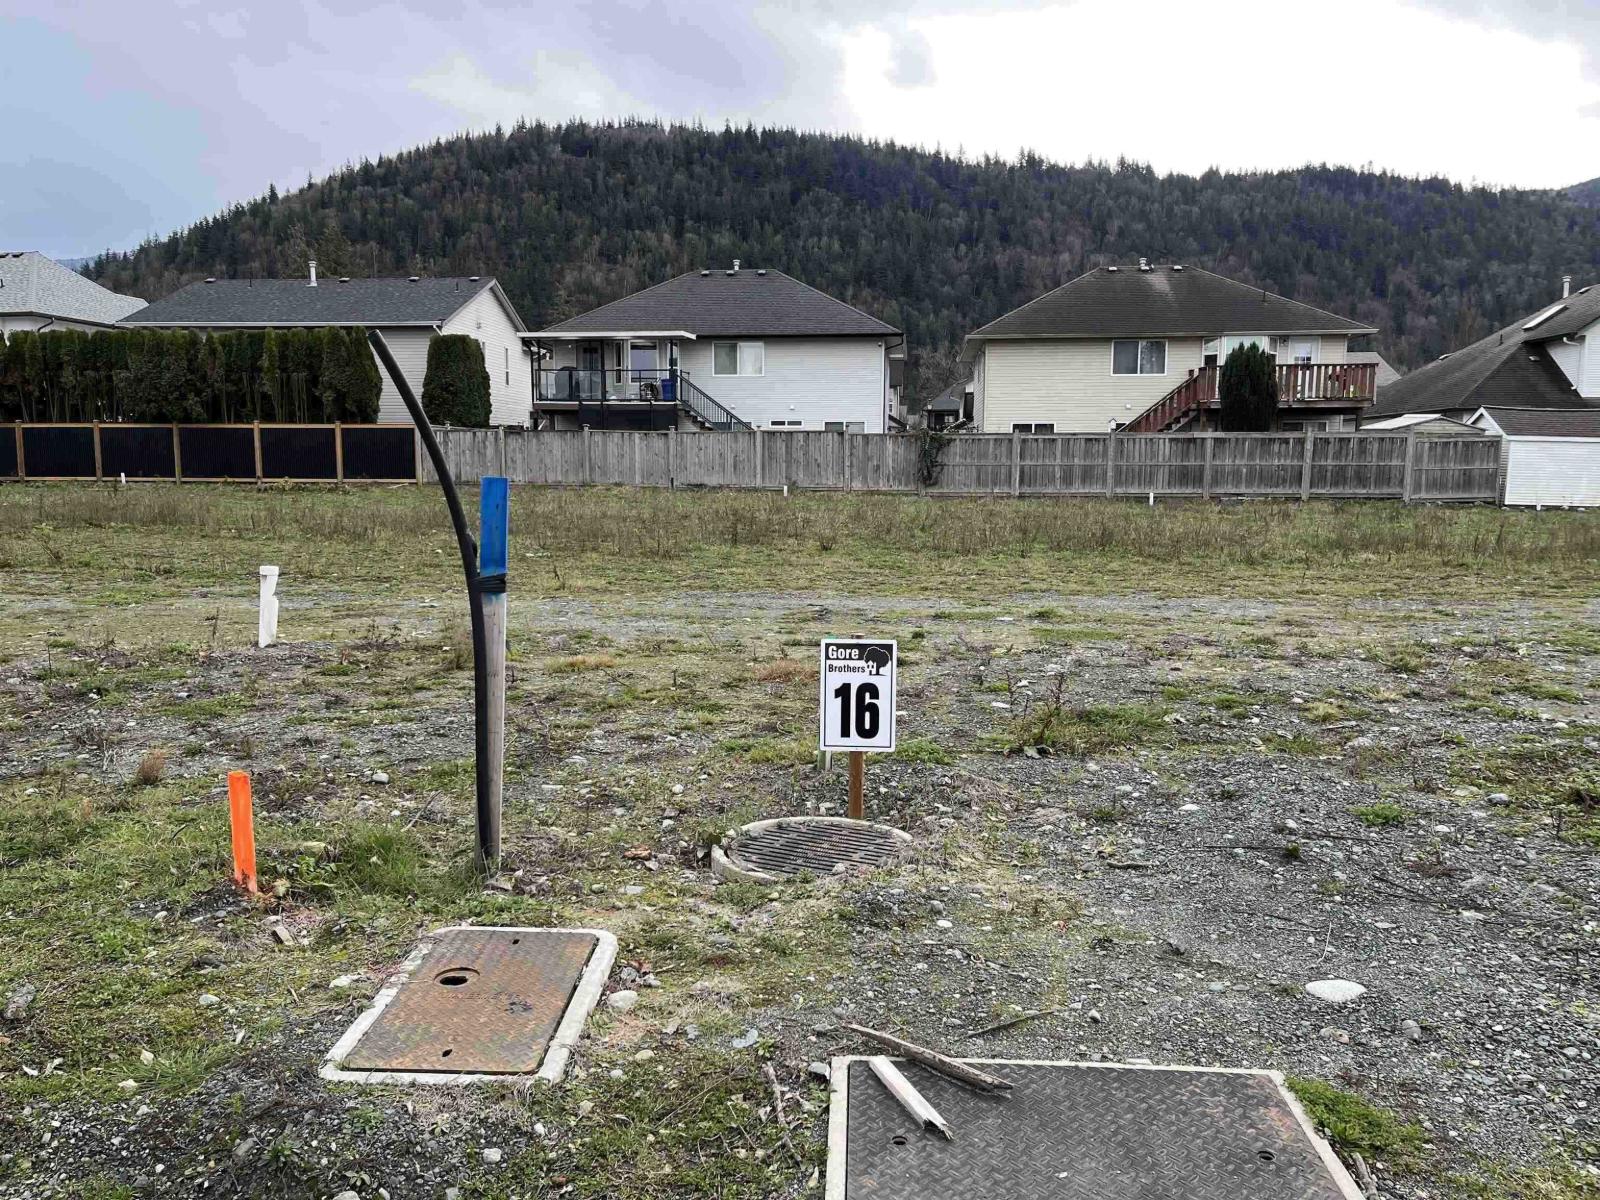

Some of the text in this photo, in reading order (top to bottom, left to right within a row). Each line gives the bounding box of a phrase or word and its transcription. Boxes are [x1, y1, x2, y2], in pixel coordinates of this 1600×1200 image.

[828, 645, 859, 659] Gore
[828, 664, 866, 673] Brothers
[834, 682, 880, 739] 16
